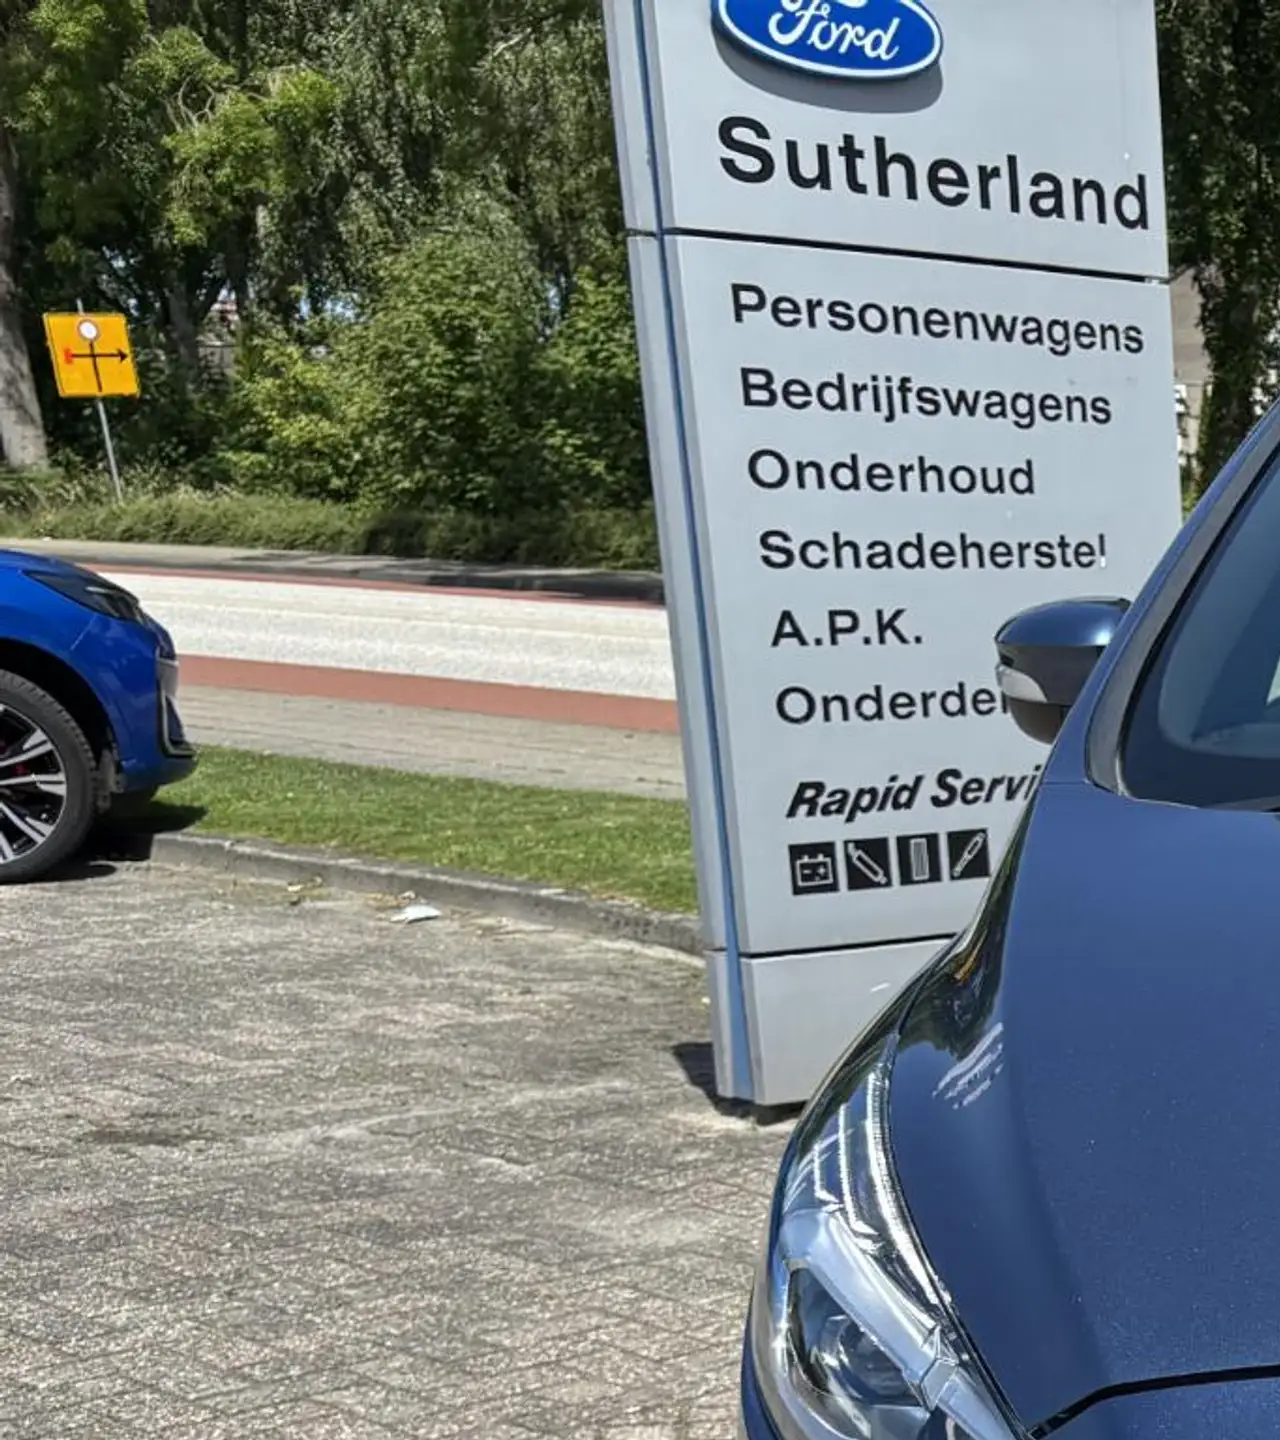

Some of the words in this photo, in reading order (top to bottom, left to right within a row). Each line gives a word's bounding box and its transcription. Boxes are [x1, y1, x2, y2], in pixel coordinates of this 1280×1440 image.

[767, 0, 901, 61] Ford
[717, 117, 1149, 230] Sutherland
[731, 283, 1144, 356] Personenwagens
[740, 367, 1112, 429] Bedrijfswagens
[748, 449, 1035, 495] Onderhoud
[771, 608, 922, 647] A.P.K.
[785, 774, 924, 824] Rapid
